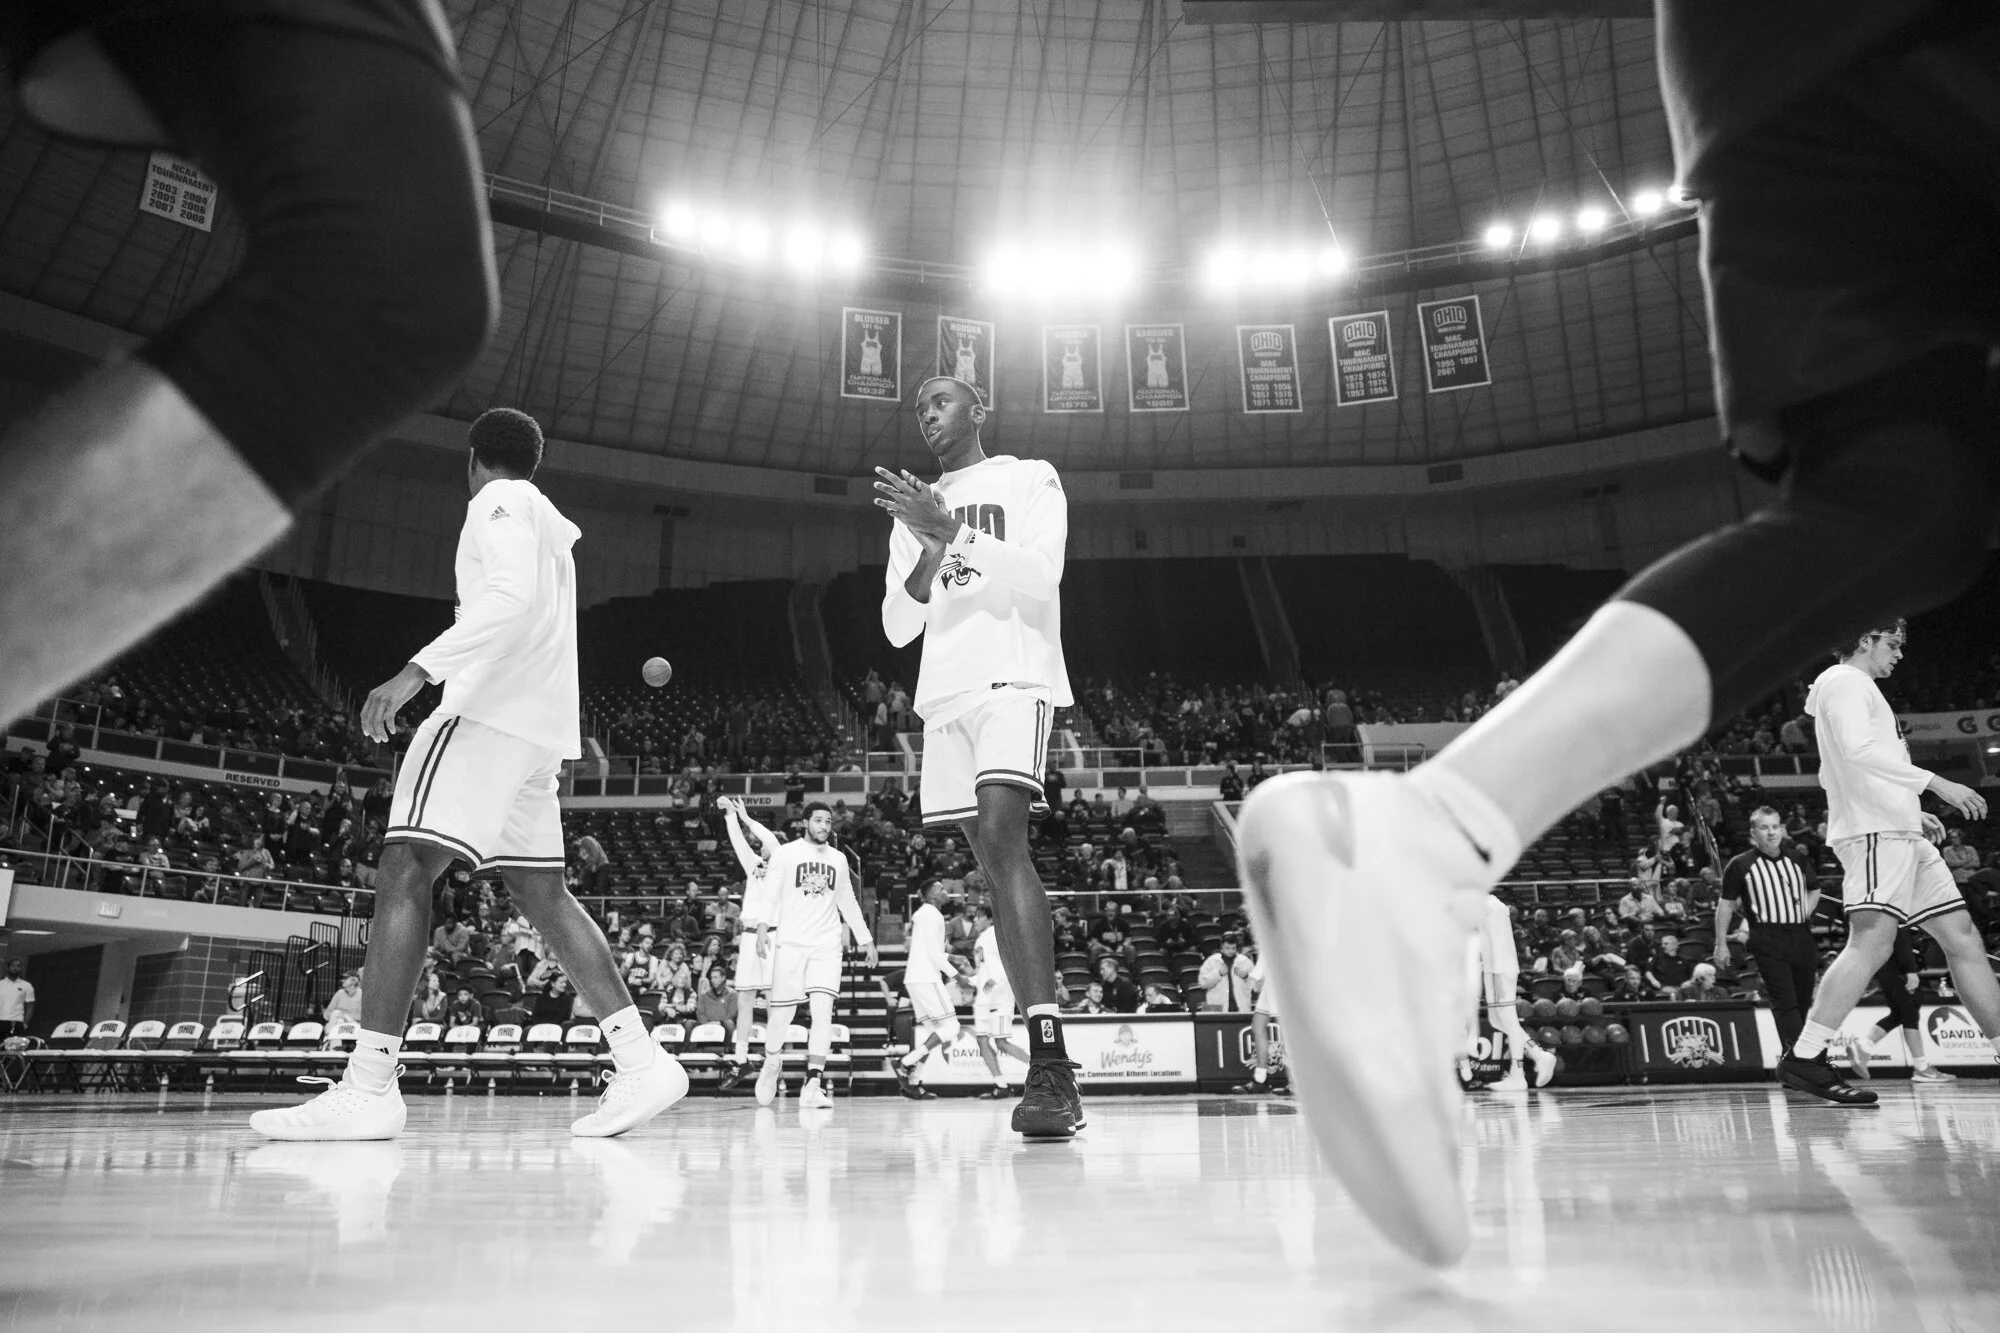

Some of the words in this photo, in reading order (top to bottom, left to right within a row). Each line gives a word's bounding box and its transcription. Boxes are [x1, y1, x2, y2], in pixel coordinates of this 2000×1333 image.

[152, 164, 215, 192] TOURNAMENT
[172, 163, 198, 178] NCAA
[151, 189, 176, 204] 2005
[149, 198, 174, 213] 2007
[1434, 306, 1467, 328] OHIO
[1344, 321, 1377, 342] OHIO
[1445, 334, 1462, 342] MAC
[1252, 332, 1283, 351] OHIO
[1430, 338, 1479, 352] TOURNAMENT
[1340, 354, 1388, 366] TOURNAMENT
[1354, 349, 1372, 357] MAC
[1434, 346, 1478, 359] CHAMPIONS
[1343, 362, 1386, 373] CHAMPIONS
[1957, 715, 1979, 734] G
[225, 772, 280, 787] RESERVED
[795, 861, 837, 892] OHIO
[177, 1025, 196, 1035] OHIO
[1661, 1015, 1723, 1059] OHIO
[1940, 1029, 1976, 1039] DAVID
[952, 1048, 981, 1058] DAVI
[1100, 1048, 1153, 1070] Wendy's
[1087, 1070, 1125, 1078] Convenient
